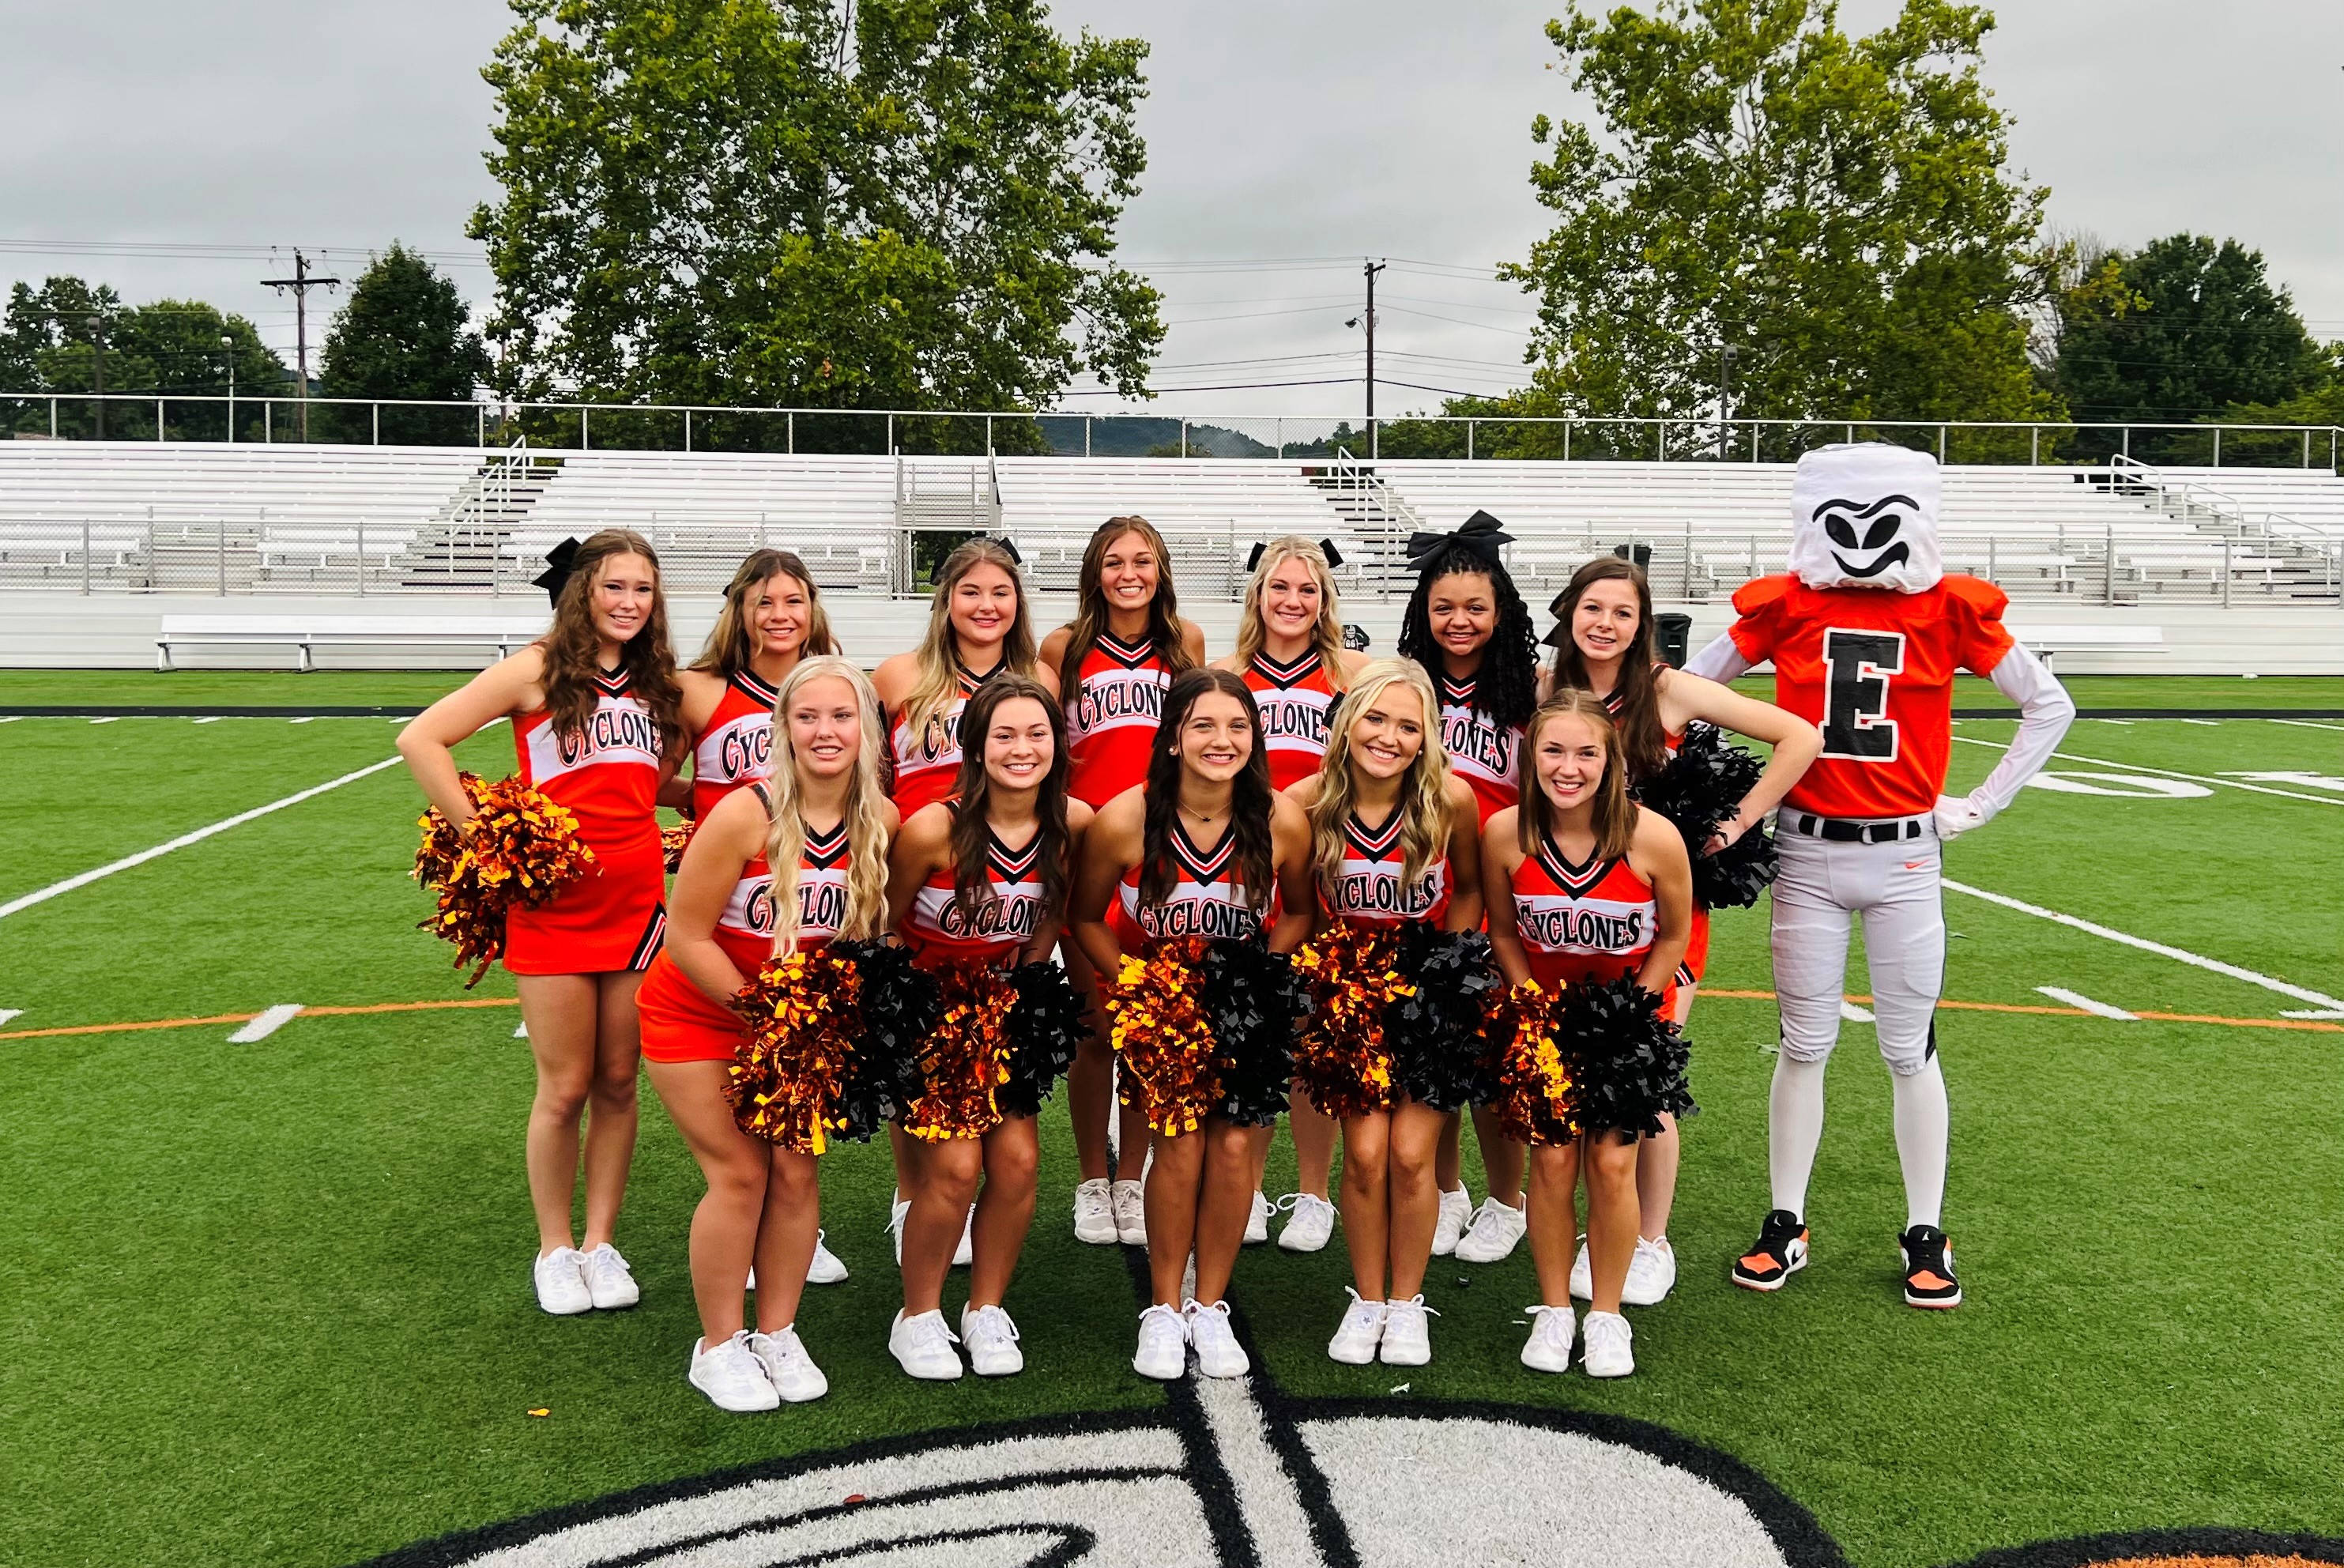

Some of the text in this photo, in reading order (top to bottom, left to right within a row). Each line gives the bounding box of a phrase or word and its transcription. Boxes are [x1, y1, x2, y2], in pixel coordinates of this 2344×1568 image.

[1076, 680, 1170, 732] CYCLON
[1819, 627, 1906, 763] E
[556, 710, 663, 765] CYCLONE
[1259, 702, 1332, 746] CLONE
[1440, 718, 1510, 775] LONES
[938, 892, 1040, 938] CYCLON
[1332, 873, 1437, 914] YCLONES
[1518, 903, 1642, 948] CYCLONES
